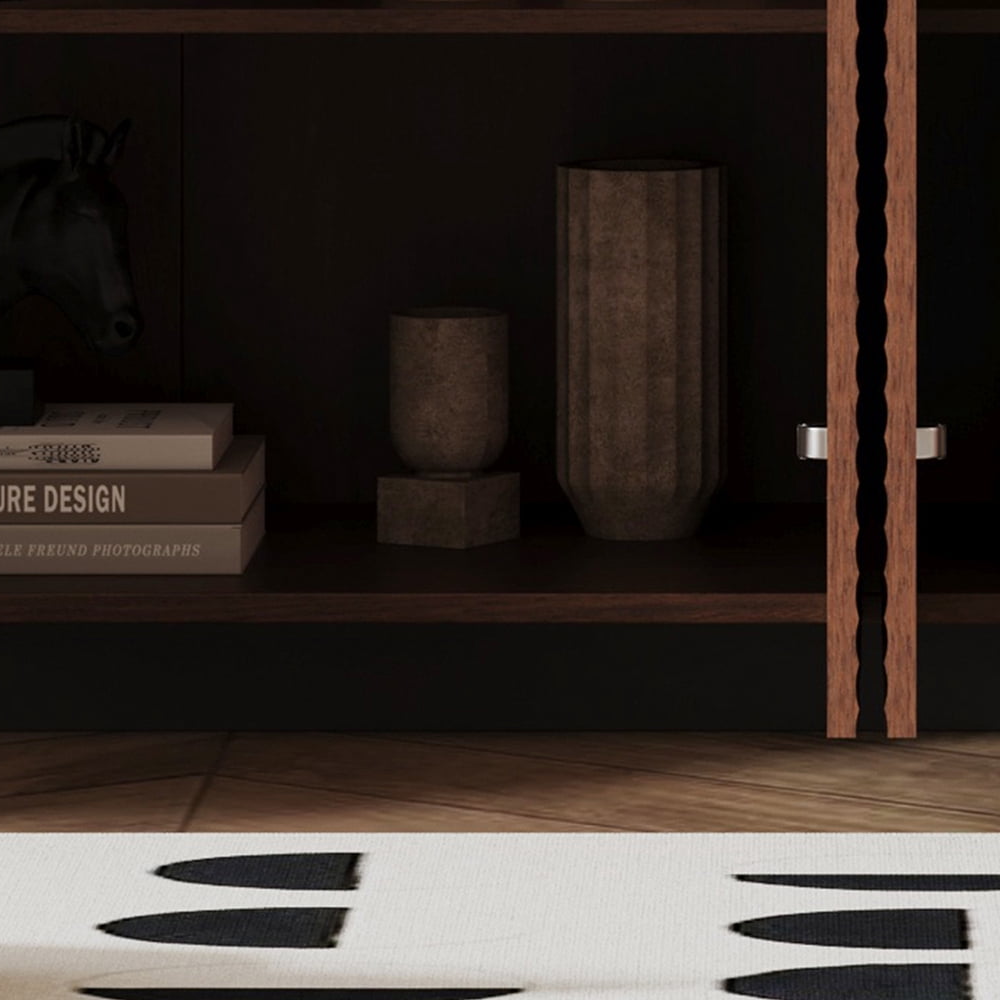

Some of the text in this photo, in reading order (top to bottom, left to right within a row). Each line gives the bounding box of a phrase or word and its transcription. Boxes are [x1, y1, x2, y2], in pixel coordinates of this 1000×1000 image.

[45, 485, 125, 513] DESIGN
[28, 544, 87, 556] FREUND
[93, 544, 200, 556] PHOTOGRAPHS
